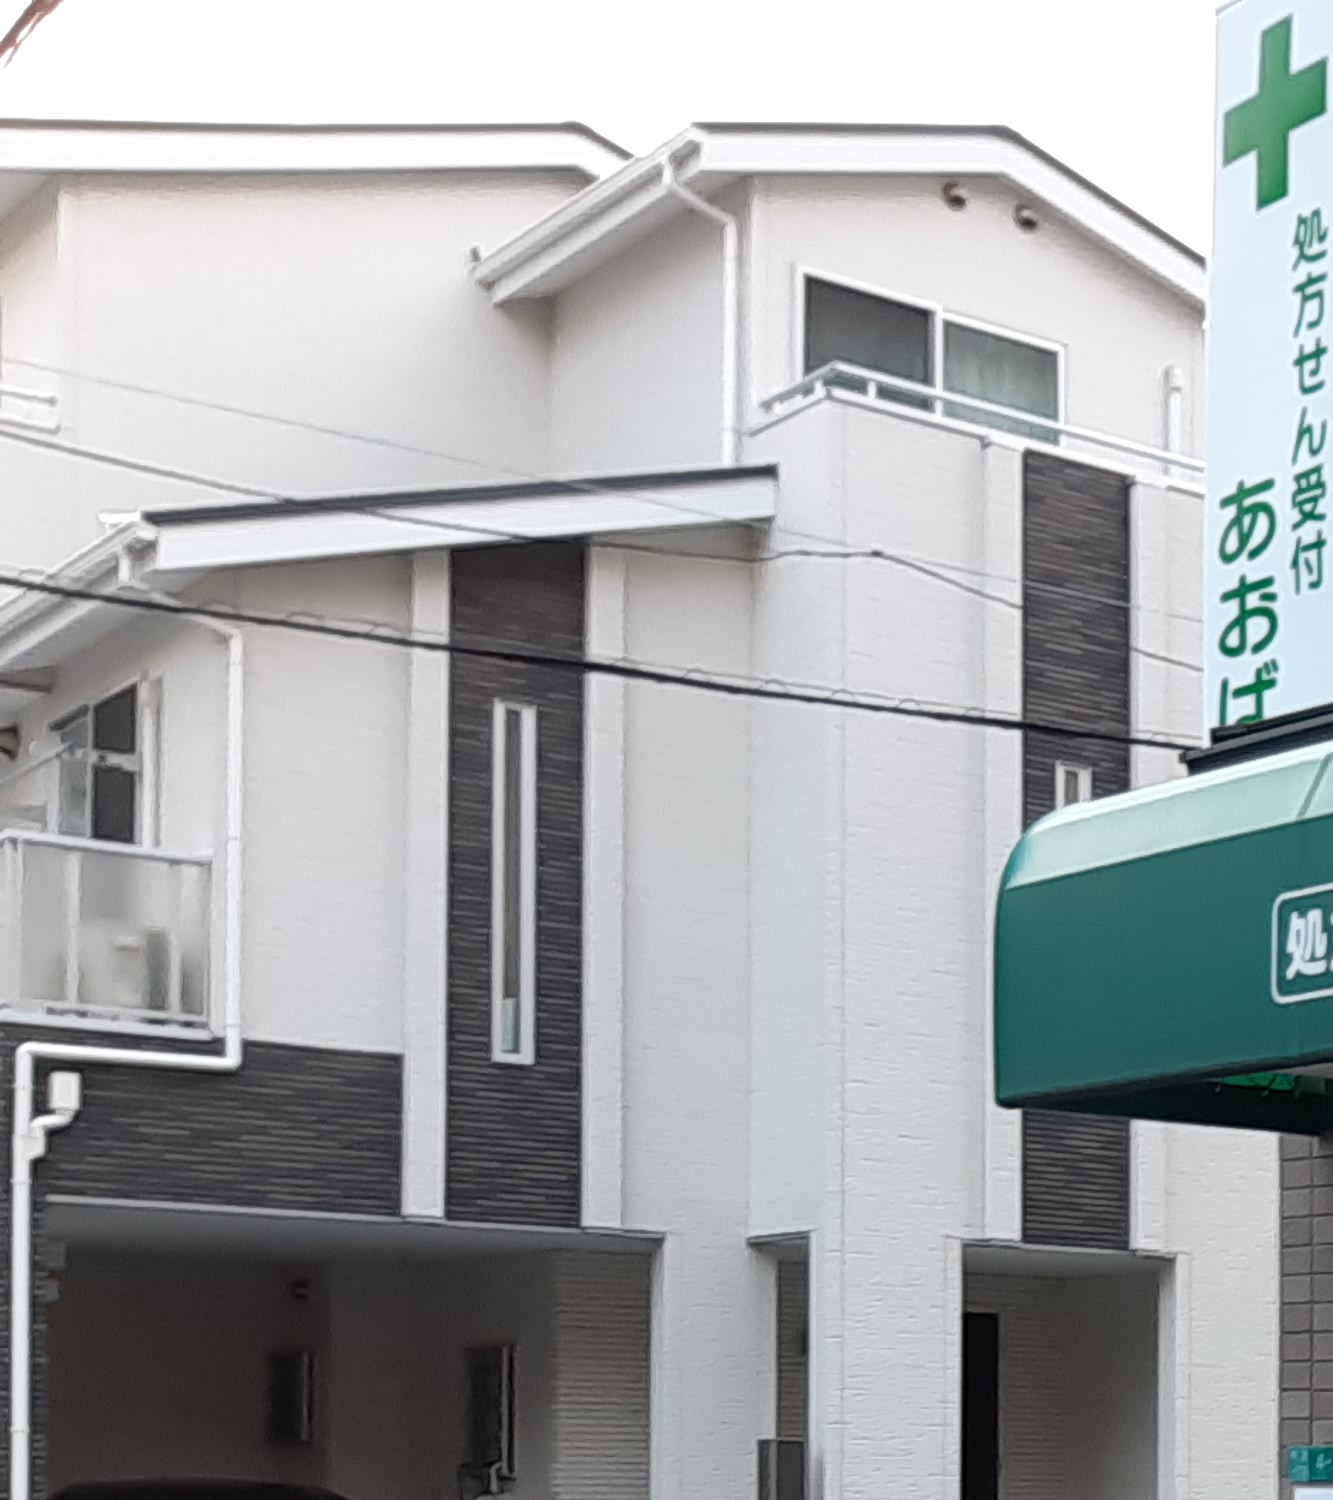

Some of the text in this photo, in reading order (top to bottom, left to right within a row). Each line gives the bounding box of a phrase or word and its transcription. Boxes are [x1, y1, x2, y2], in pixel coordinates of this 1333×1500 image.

[1291, 207, 1329, 594] 処方せん受付
[1218, 479, 1280, 727] あおば
